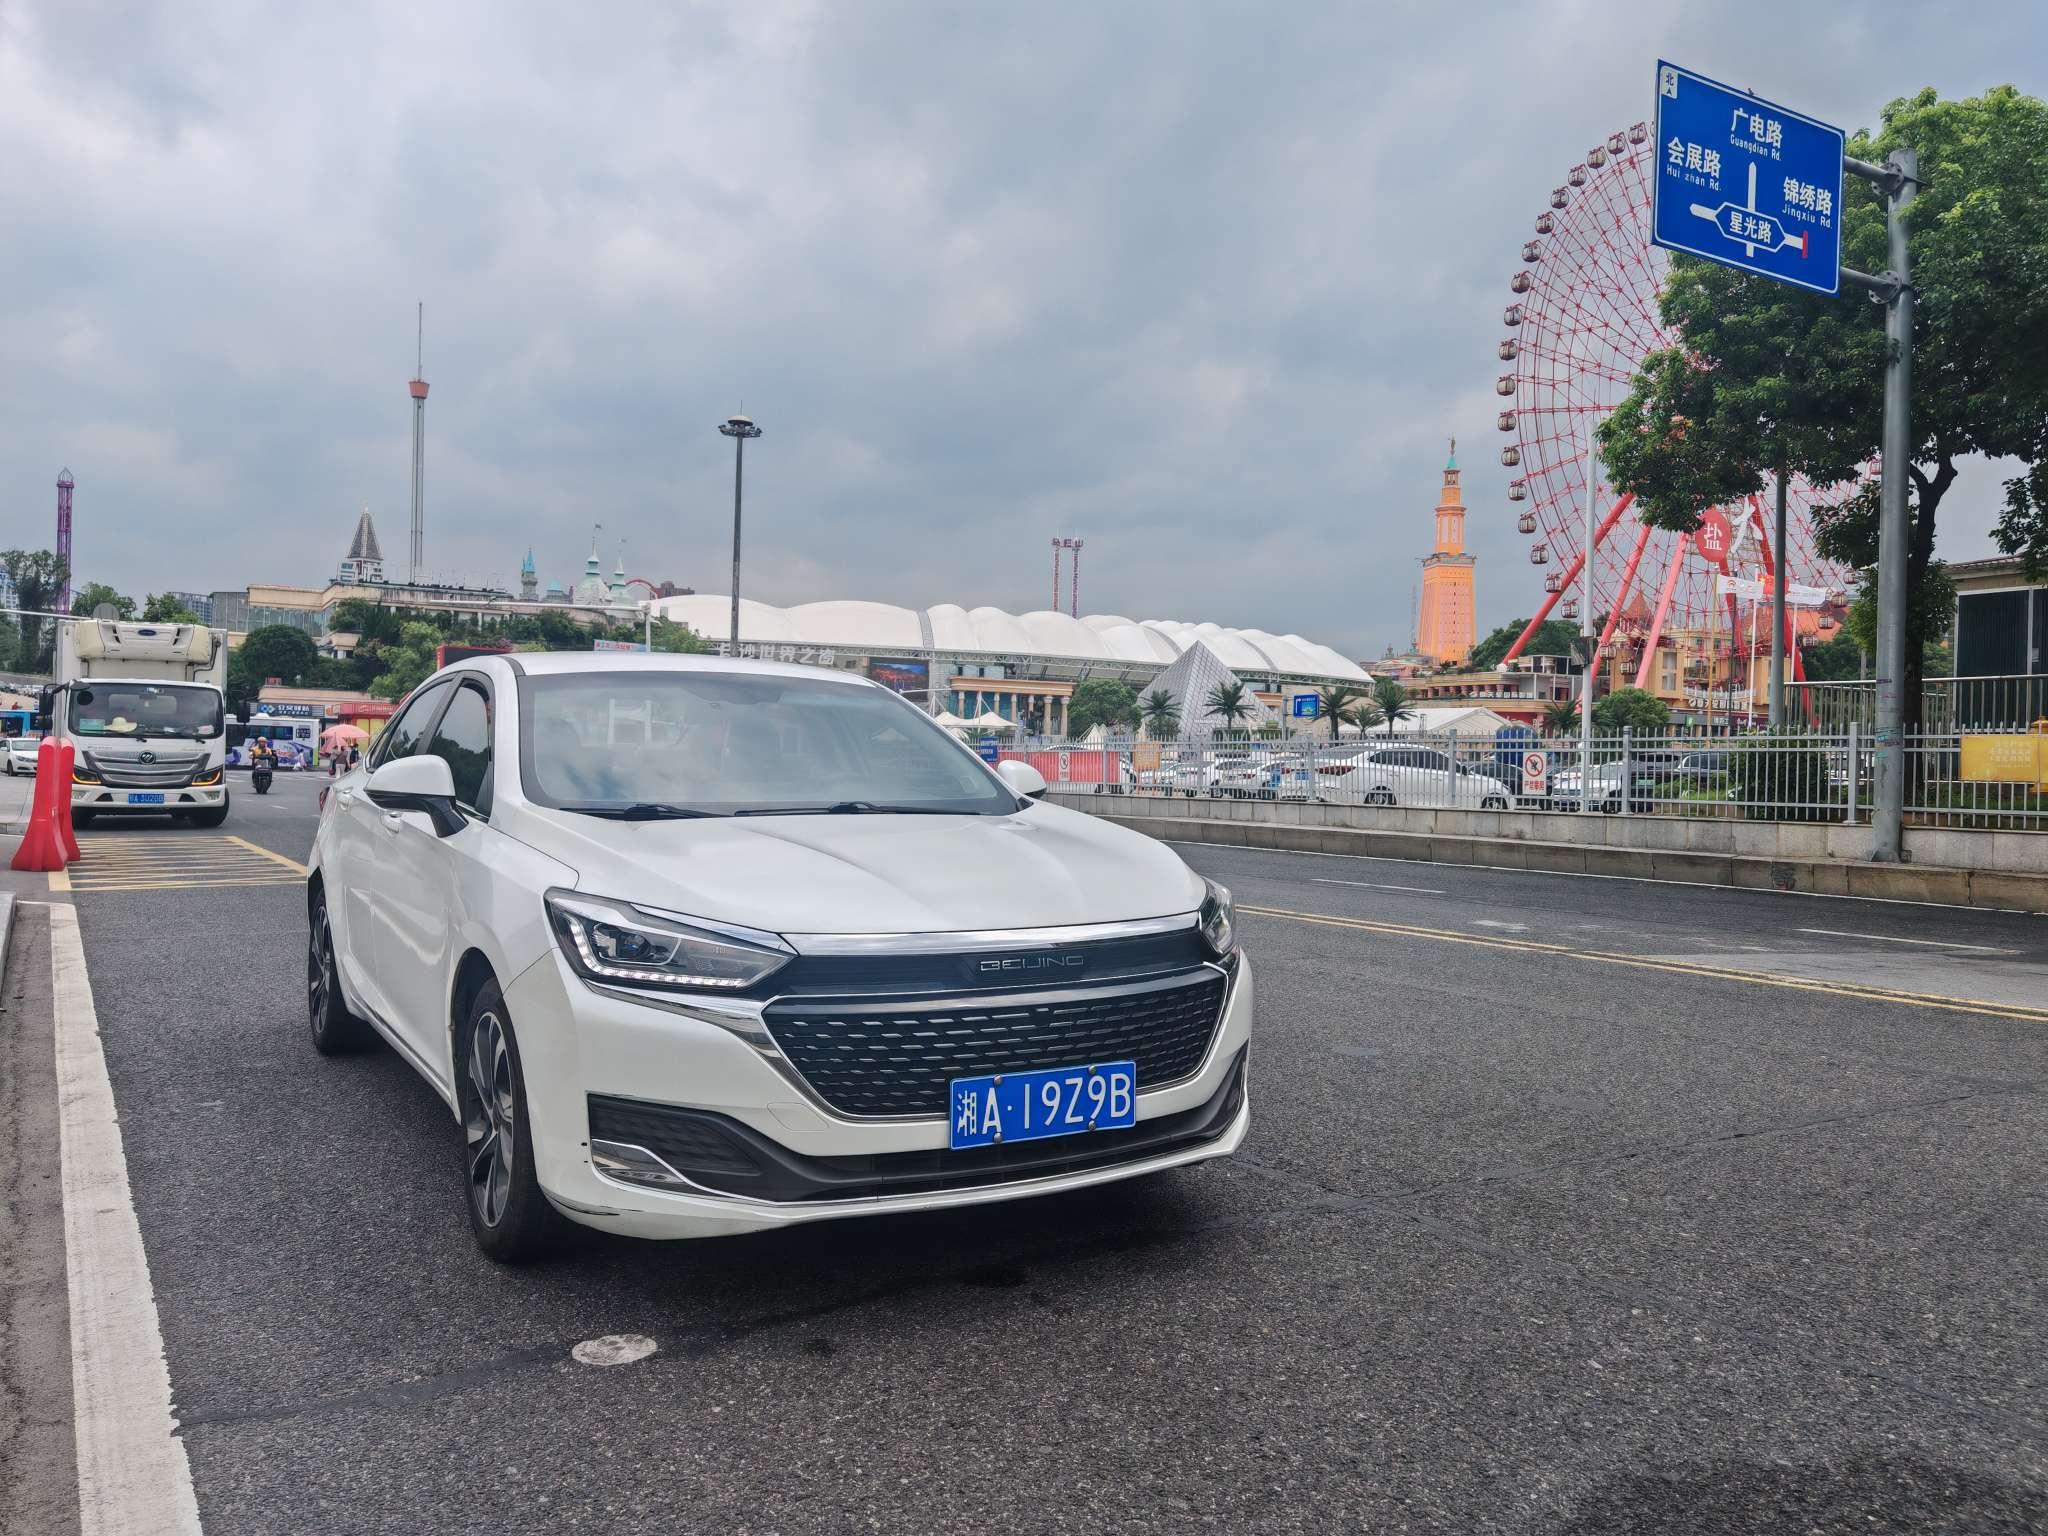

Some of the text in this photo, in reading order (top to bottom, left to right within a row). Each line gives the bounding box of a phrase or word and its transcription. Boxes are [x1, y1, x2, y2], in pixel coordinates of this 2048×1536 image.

[1666, 72, 1674, 87] 北
[1731, 107, 1783, 149] 广电路
[1667, 136, 1722, 178] 会展路
[1730, 134, 1782, 161] Guangdian Rd.
[1666, 163, 1722, 191] Hui zhan Rd.
[1783, 176, 1832, 217] 锦绣路
[1729, 211, 1772, 244] 星光路
[1782, 204, 1833, 229] Jingxiu Rd.
[1703, 522, 1723, 551] 盐
[979, 955, 1084, 972] BEIJING
